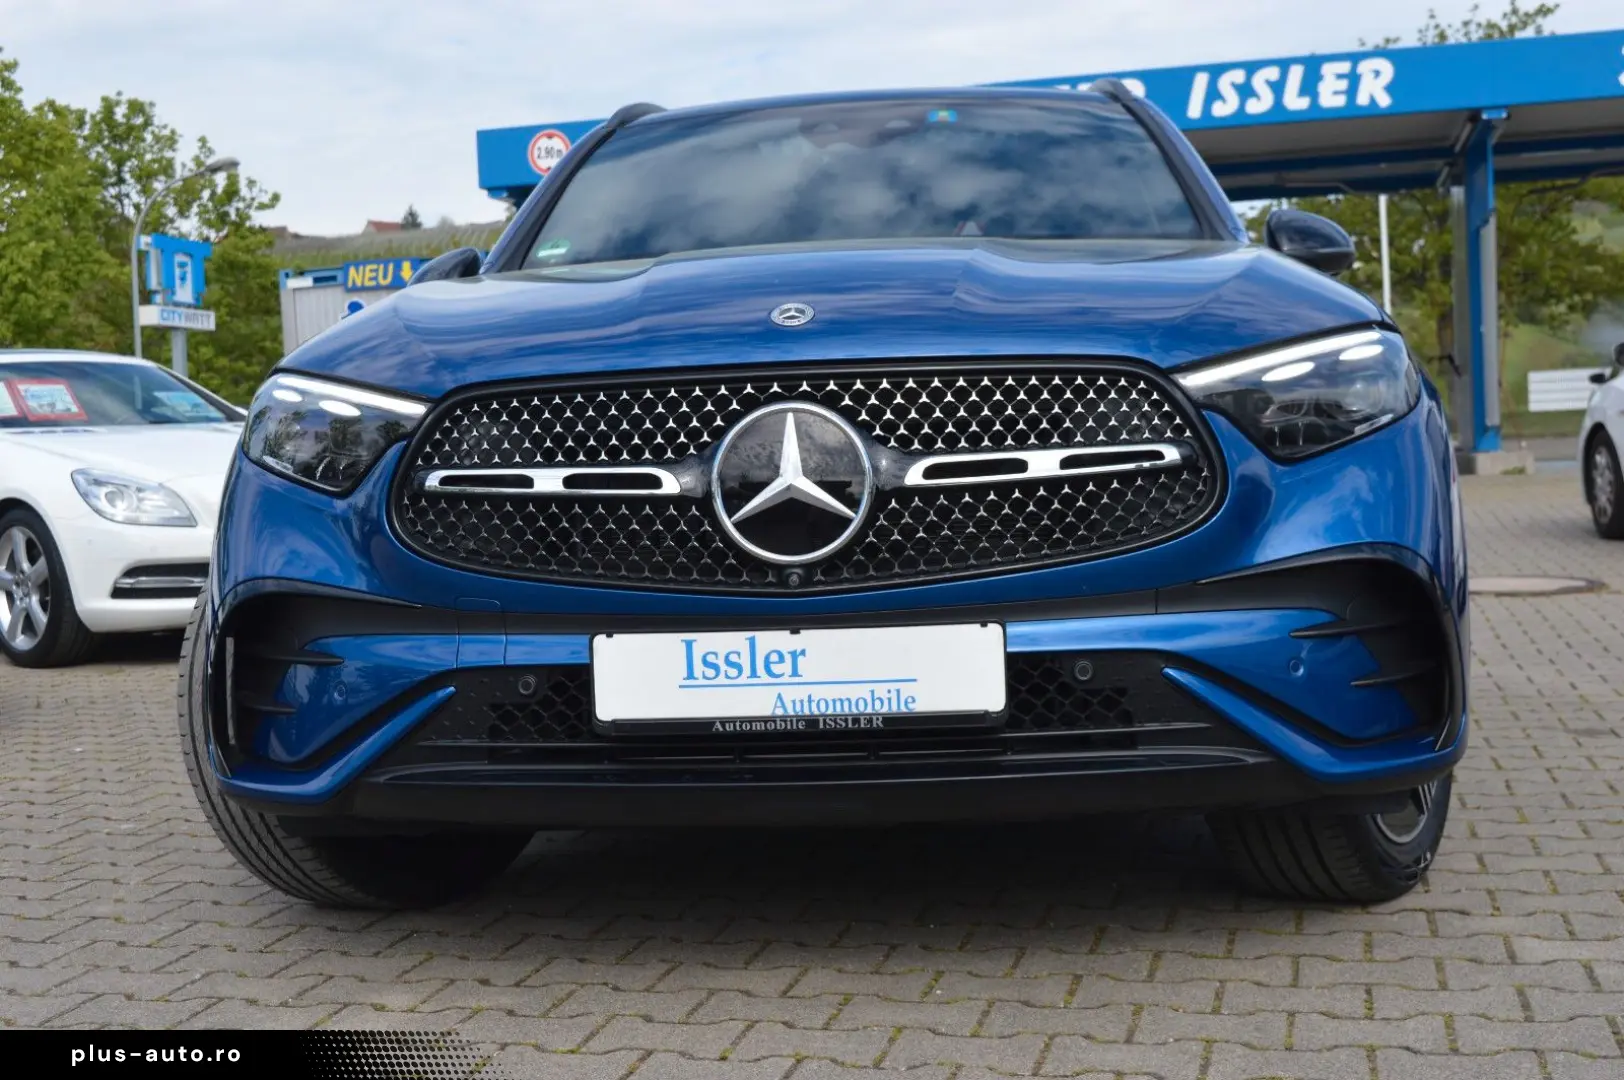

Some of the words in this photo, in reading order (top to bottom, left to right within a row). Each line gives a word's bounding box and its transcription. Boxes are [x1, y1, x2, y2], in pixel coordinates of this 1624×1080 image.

[1187, 57, 1395, 119] ISSLER
[347, 262, 394, 288] NEU
[680, 634, 807, 681] Issler
[771, 688, 917, 716] Automobile
[712, 717, 806, 732] Automobile
[818, 715, 885, 729] ISSLER
